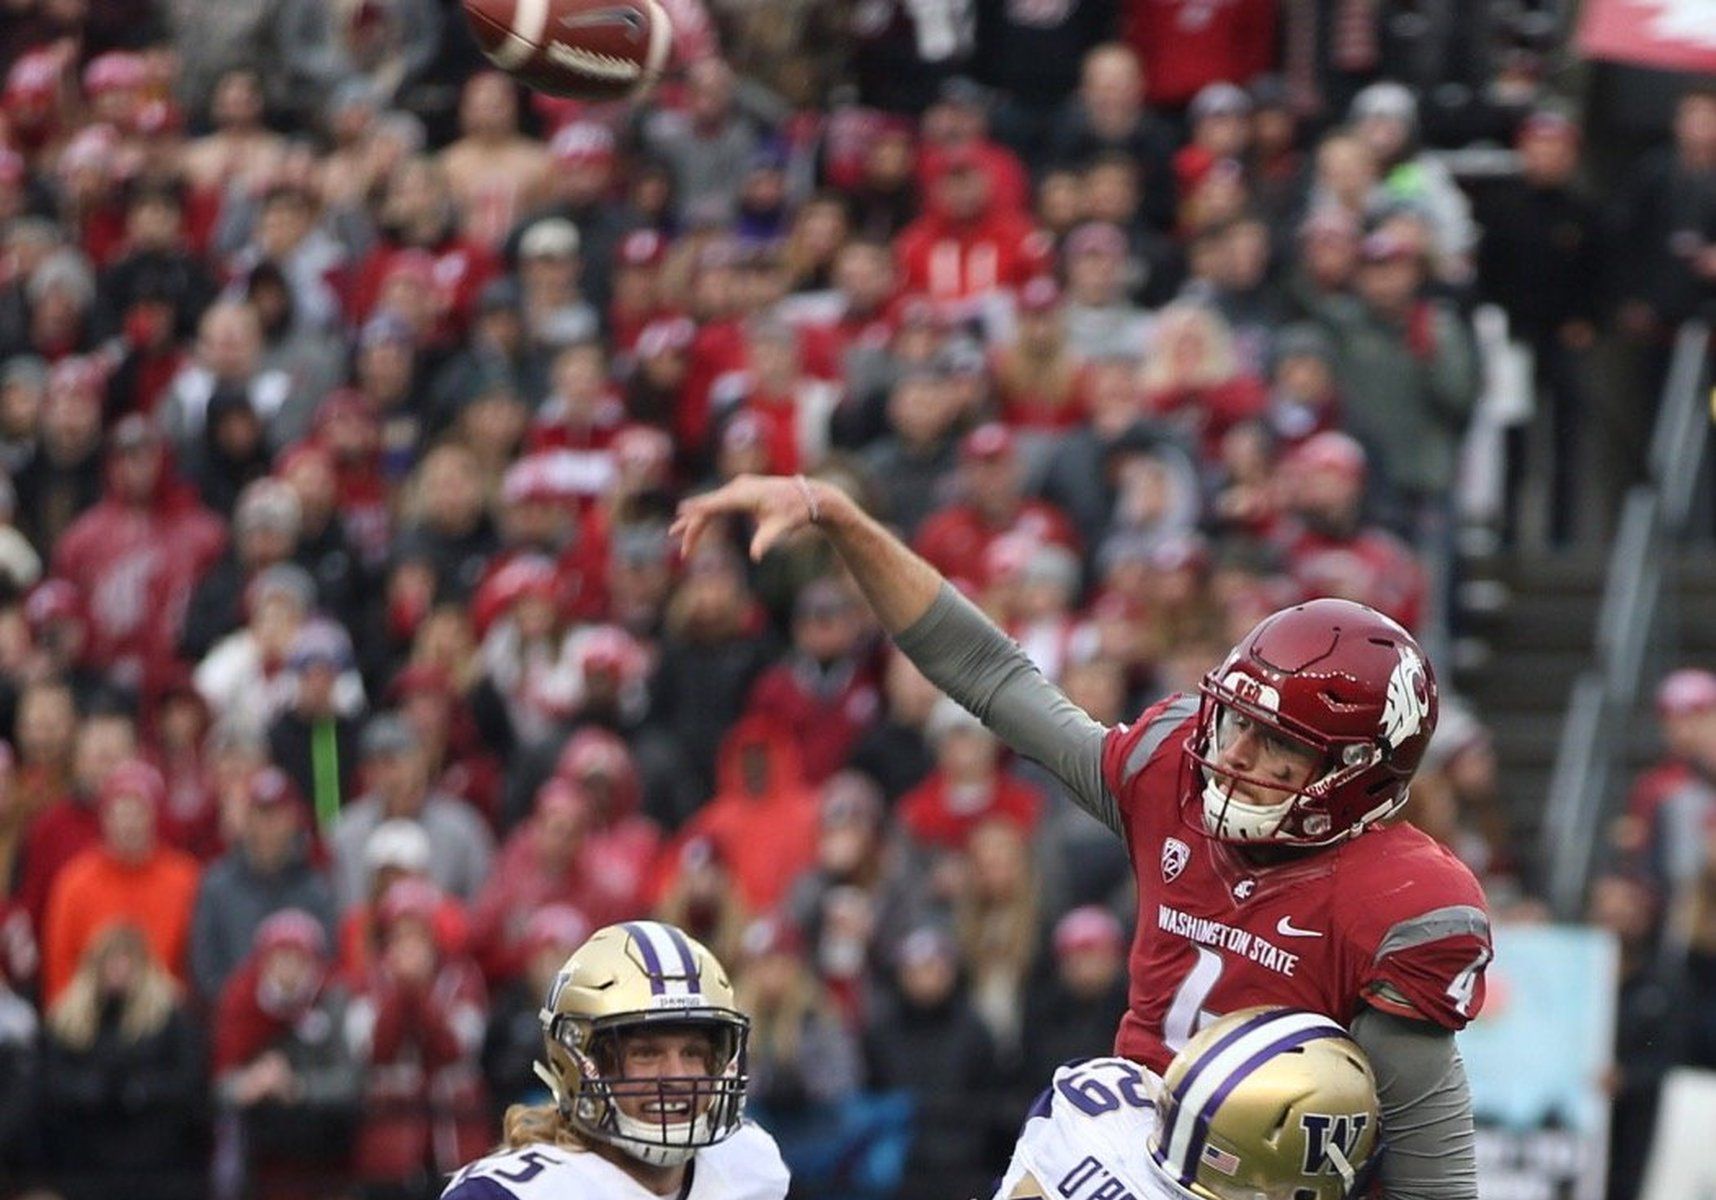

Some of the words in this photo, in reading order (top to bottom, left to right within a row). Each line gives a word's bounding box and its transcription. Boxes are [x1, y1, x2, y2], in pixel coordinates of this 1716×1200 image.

[1158, 904, 1252, 956] WASHINGTON
[1250, 936, 1299, 976] STATE
[1446, 946, 1488, 1017] 4
[1300, 1112, 1369, 1176] W
